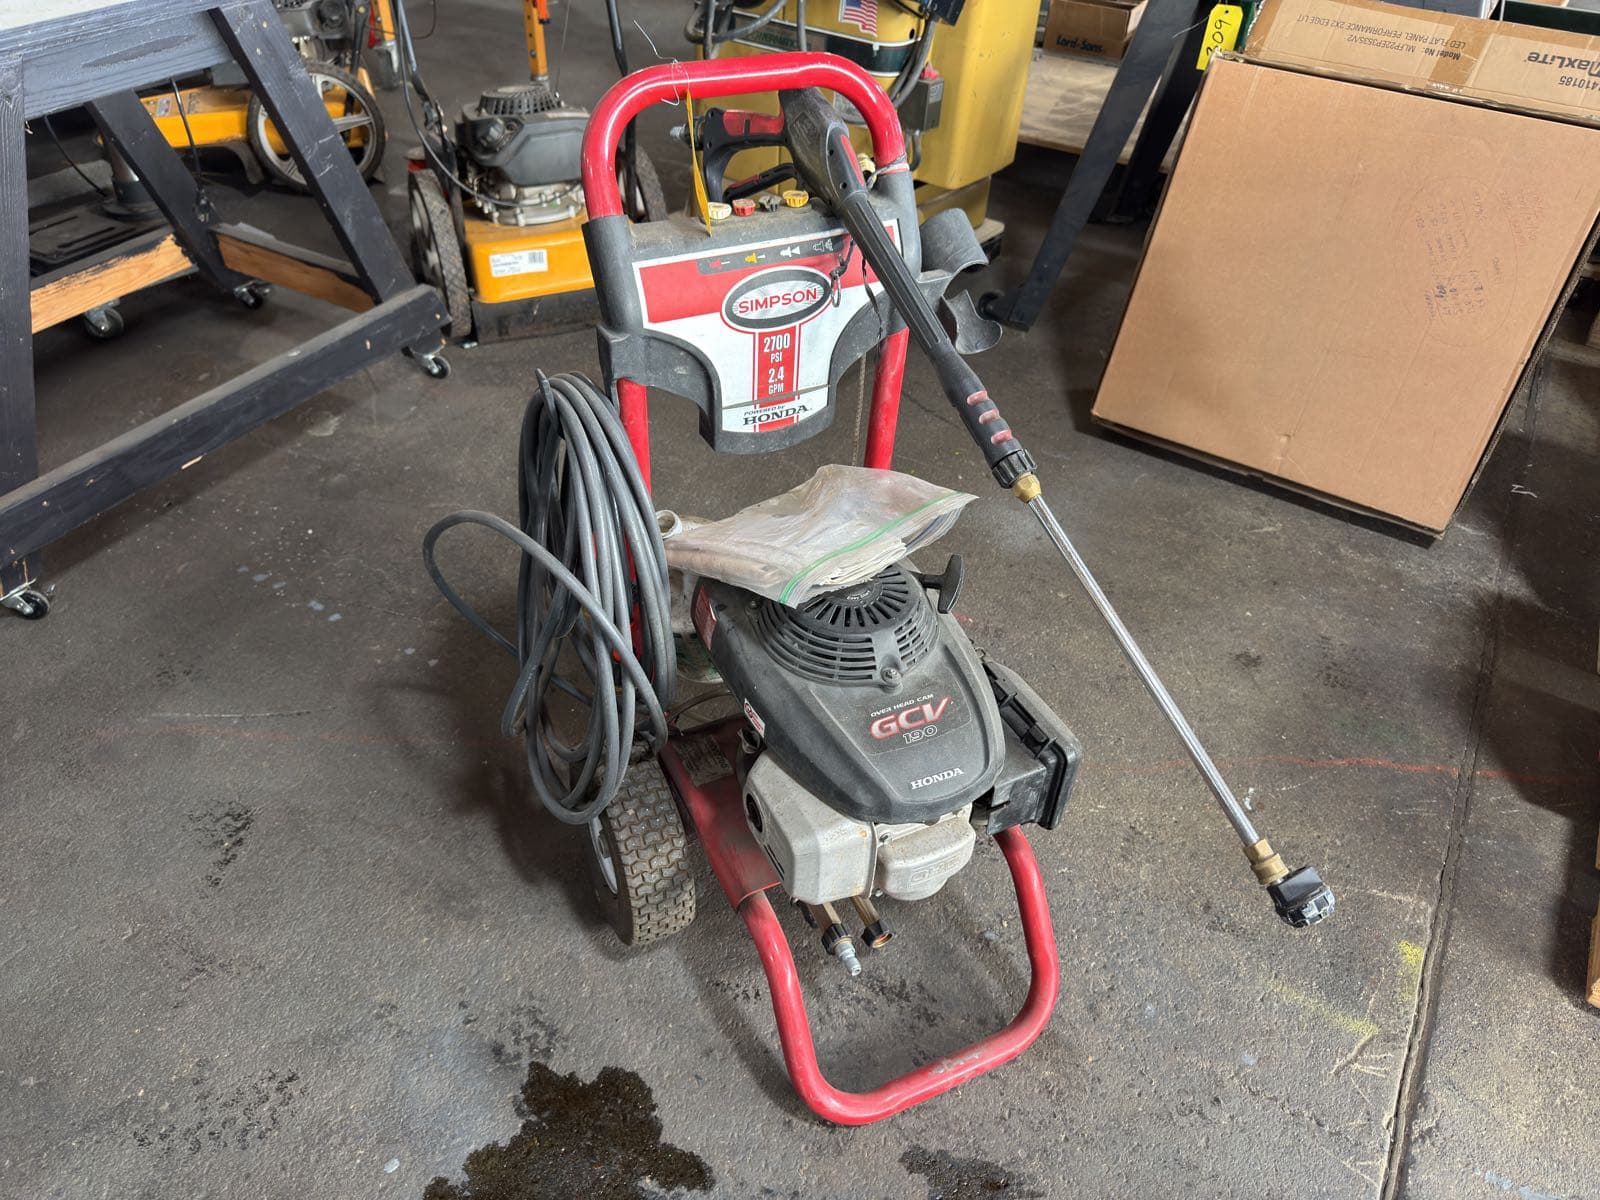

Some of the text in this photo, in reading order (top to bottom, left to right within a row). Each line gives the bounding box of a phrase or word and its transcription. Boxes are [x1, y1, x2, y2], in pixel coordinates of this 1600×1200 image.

[1345, 22, 1402, 40] PERFORMANCE
[1404, 31, 1429, 44] PANEL
[1429, 34, 1449, 47] FLAT
[1450, 40, 1466, 49] LED
[1437, 48, 1461, 61] Model
[1559, 75, 1600, 91] 410185
[738, 287, 817, 314] SIMPSON
[763, 333, 791, 353] 2700
[770, 351, 783, 364] PSI
[768, 366, 785, 383] 2.4
[768, 382, 785, 395] GPM
[743, 404, 809, 426] HONDA
[870, 693, 935, 718] OVER HEAD CAM
[870, 695, 952, 740] GCV
[910, 767, 965, 790] HONDA
